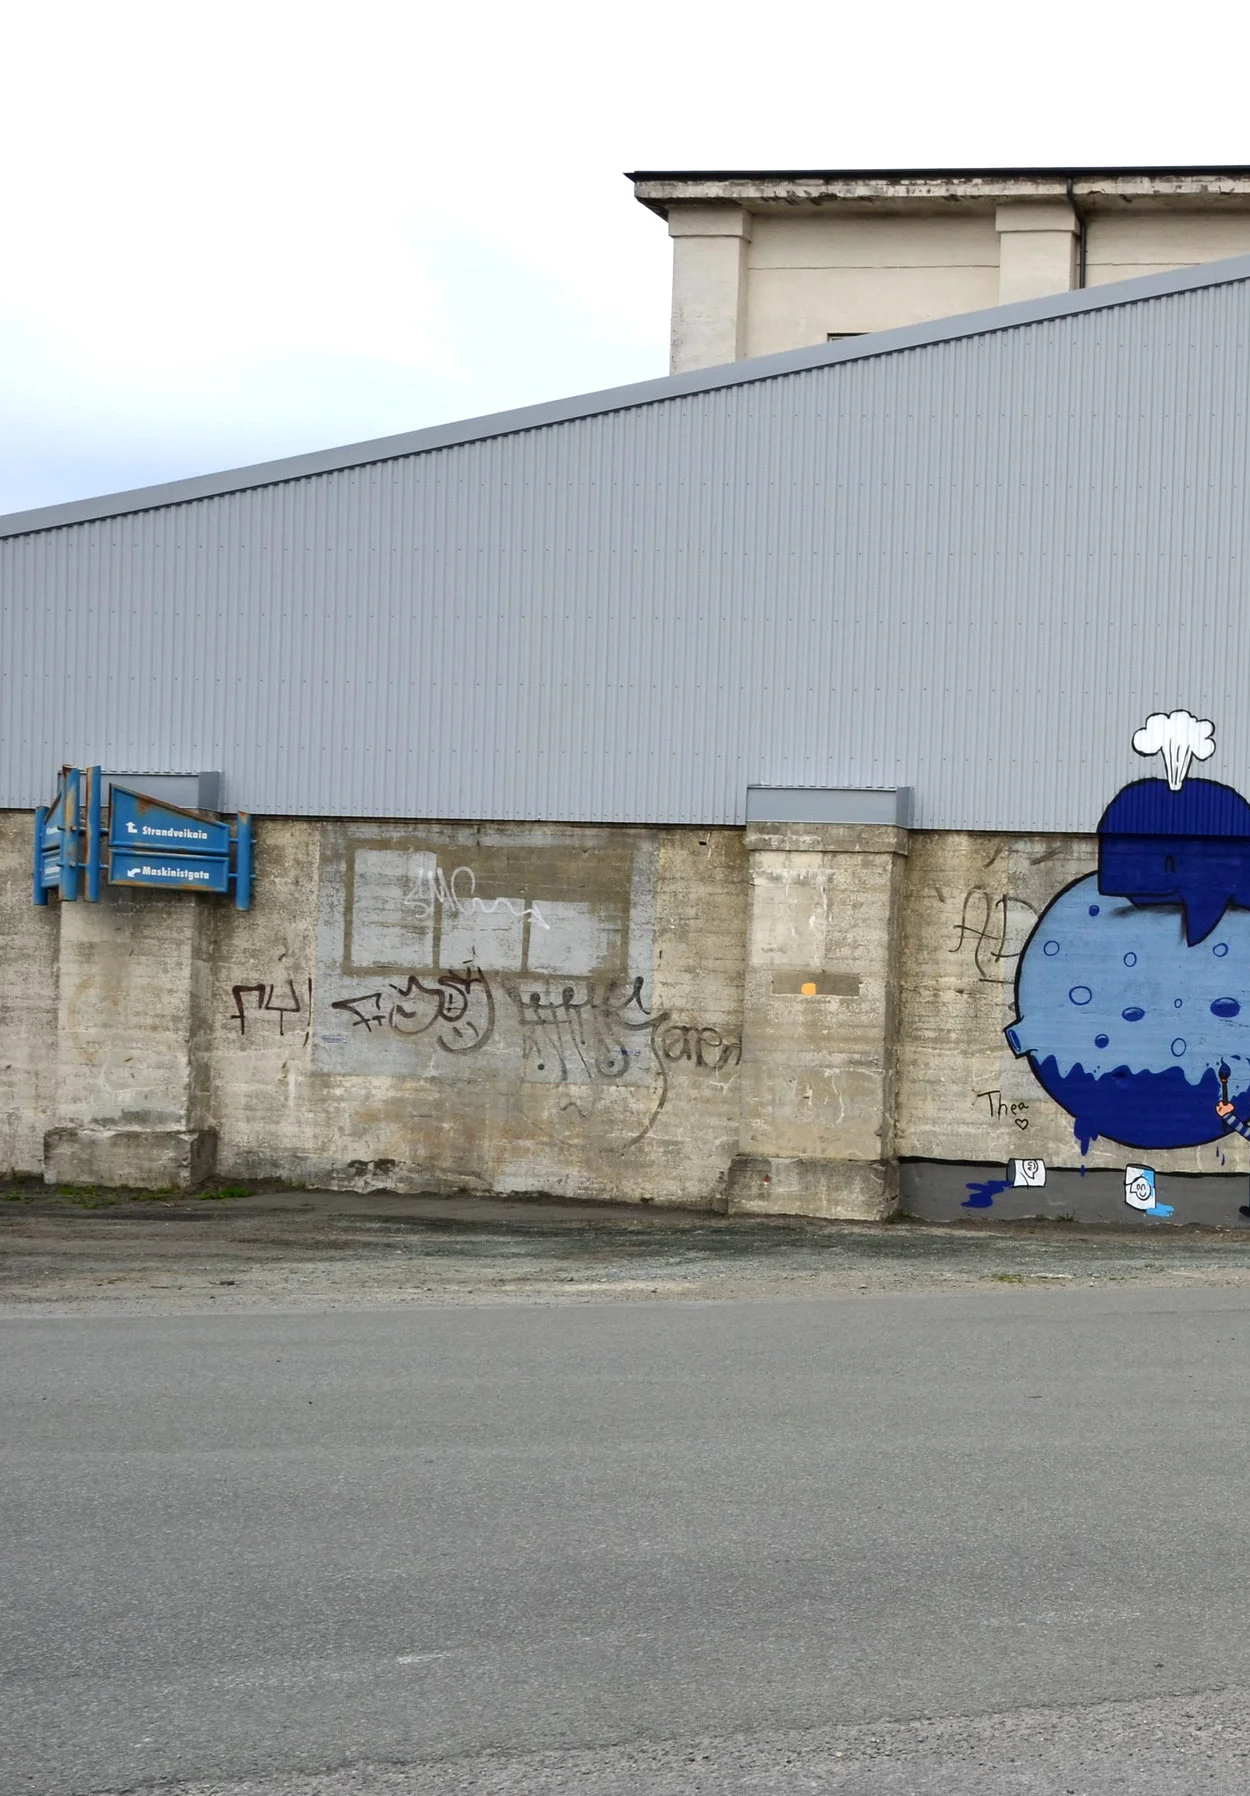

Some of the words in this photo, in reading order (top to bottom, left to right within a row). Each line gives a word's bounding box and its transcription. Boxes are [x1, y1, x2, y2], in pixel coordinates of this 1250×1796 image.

[142, 825, 208, 840] Strandveikaia
[142, 865, 210, 881] Maskinistgata
[977, 1090, 1029, 1120] Thea
